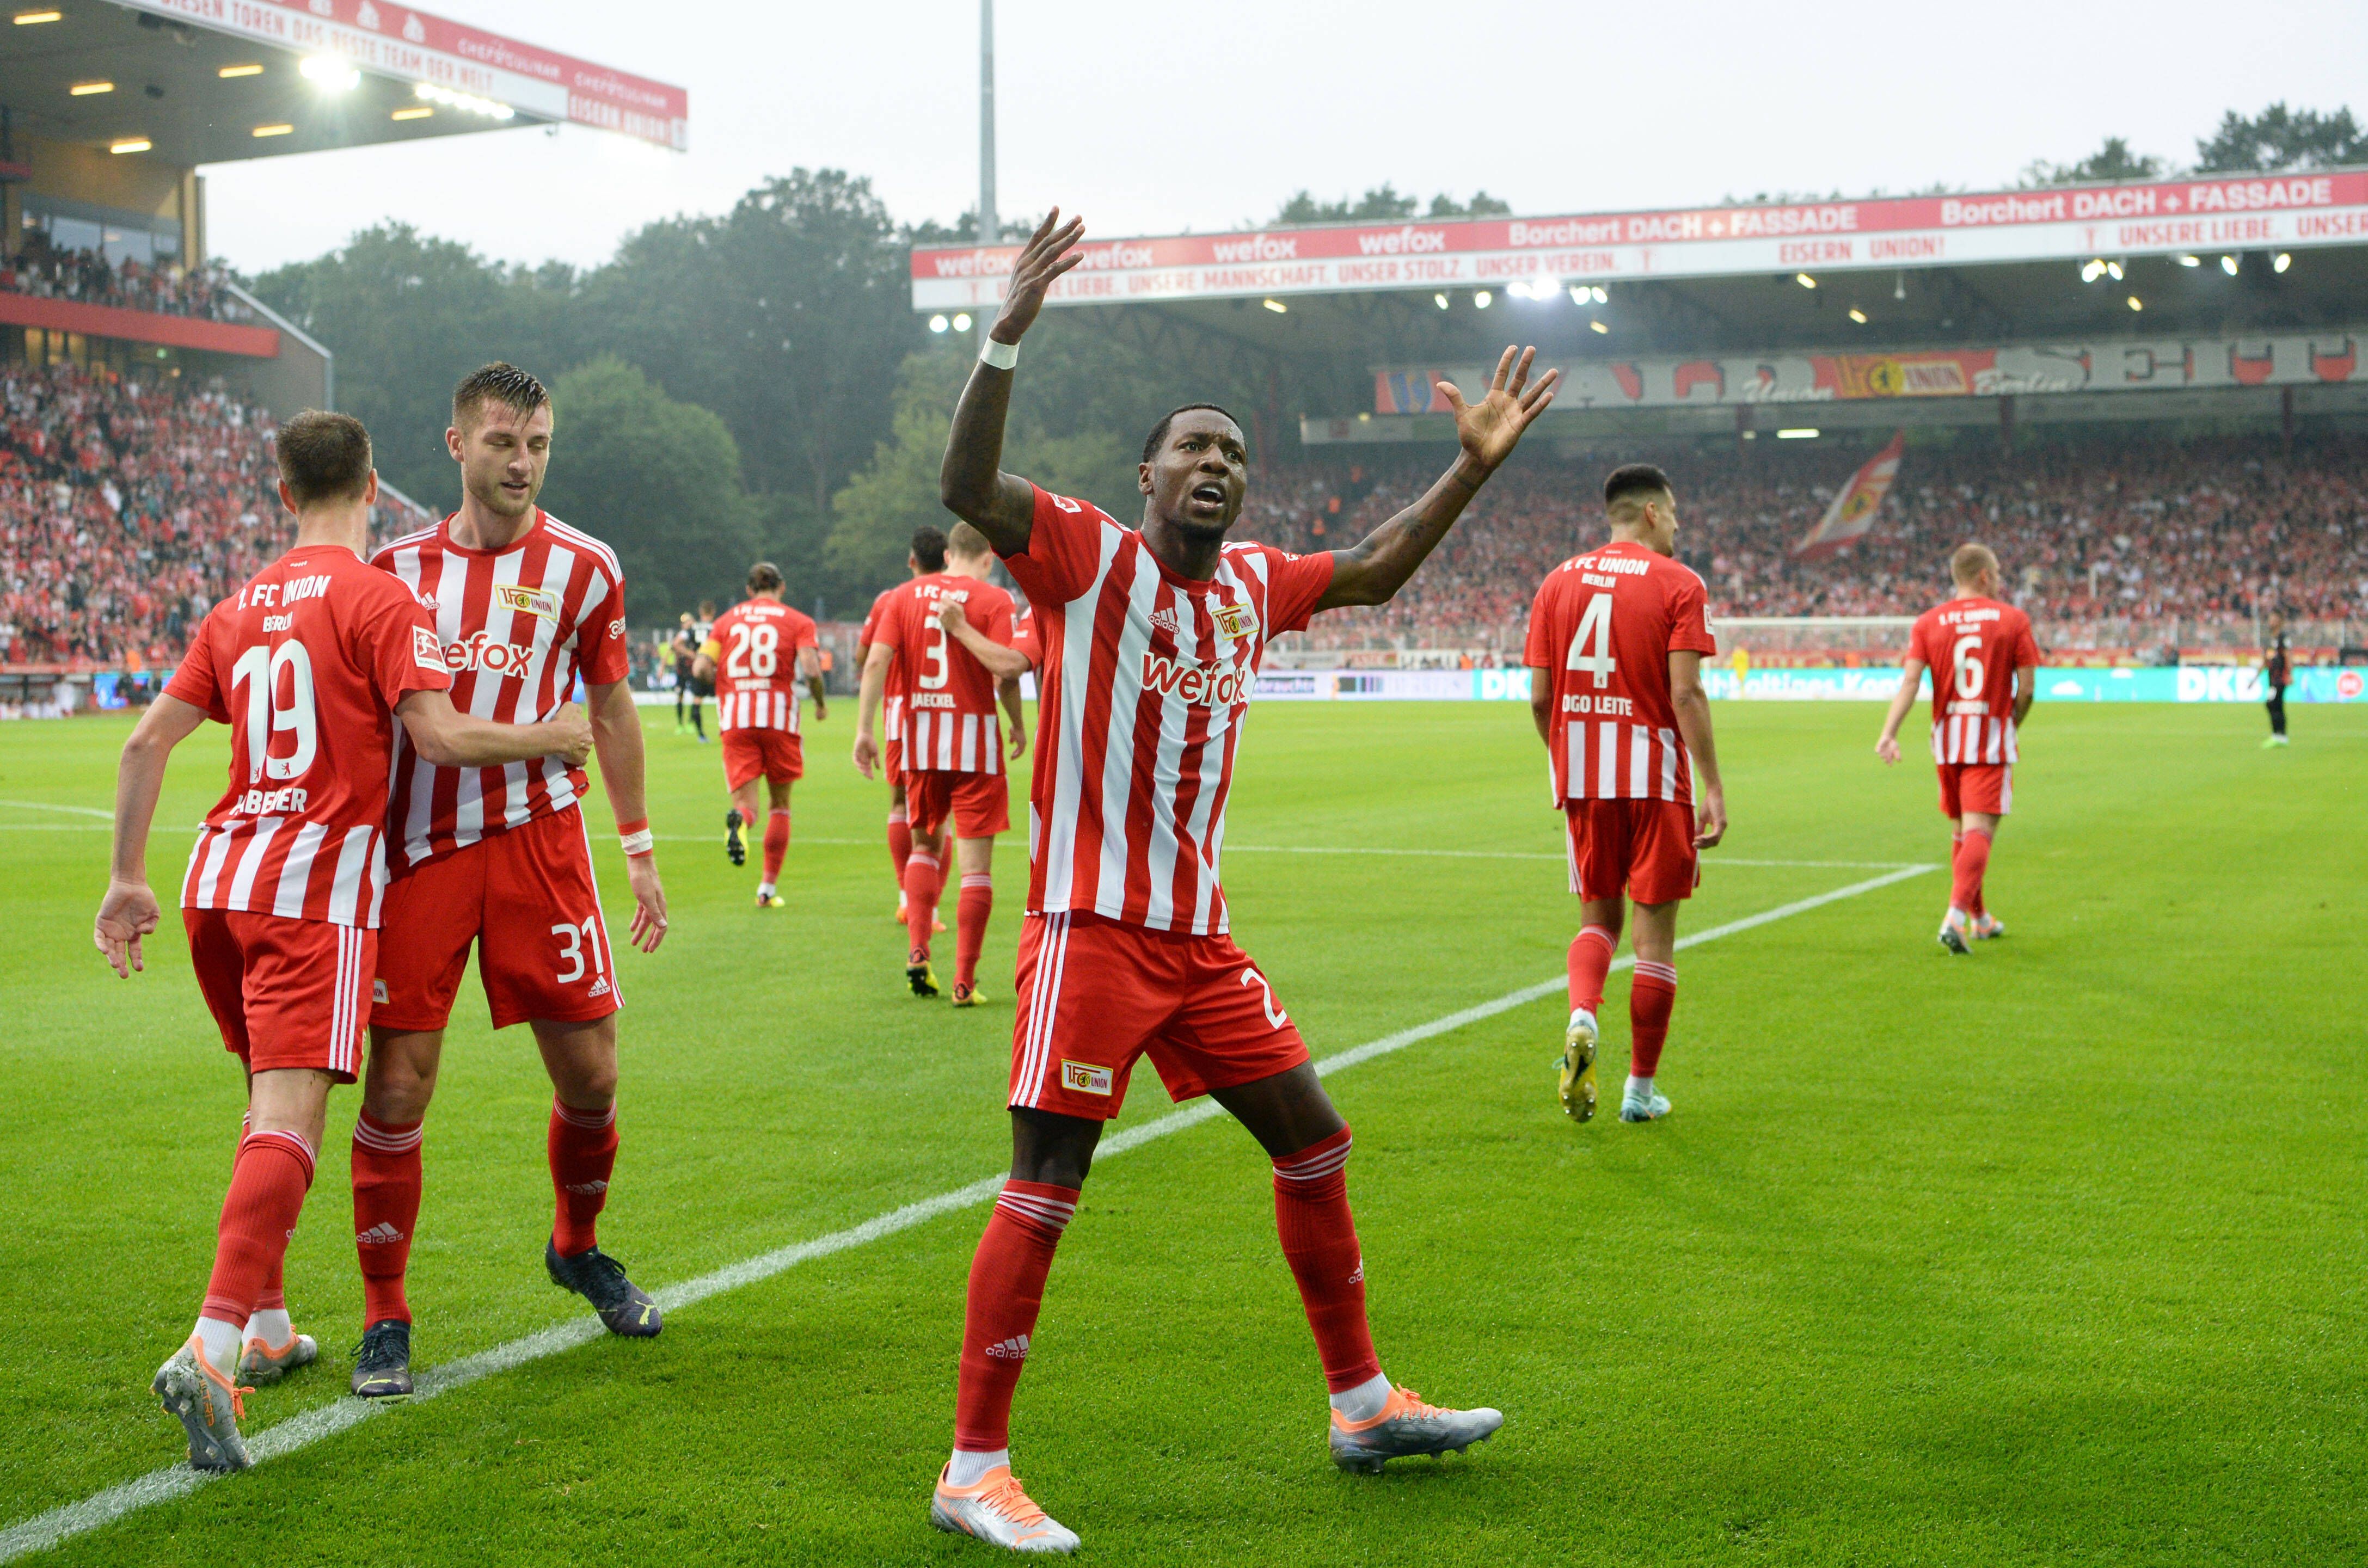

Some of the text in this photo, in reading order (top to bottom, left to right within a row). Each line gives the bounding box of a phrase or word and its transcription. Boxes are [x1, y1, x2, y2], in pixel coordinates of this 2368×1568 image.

[232, 2, 285, 35] TOREN
[383, 44, 421, 72] TEAM
[1941, 195, 2065, 225] Borchert
[2073, 189, 2156, 217] DACH
[2189, 179, 2332, 211] FASSADE
[1509, 220, 1620, 245] Borchert
[1628, 214, 1702, 240] DACH
[1730, 205, 1858, 236] FASSADE
[2119, 220, 2207, 246] UNSERE
[1212, 234, 1297, 262] wefox
[1358, 225, 1445, 255] wefox
[1779, 236, 1945, 263] EISERN UNION!
[934, 249, 1014, 276] wefox
[1074, 242, 1153, 269] wefox
[1128, 272, 1196, 293] UNSERE
[1339, 262, 1398, 283] UNSER
[1476, 256, 1538, 277] UNSER
[1575, 557, 1597, 569] FC
[1597, 557, 1650, 576] UNION
[1581, 573, 1617, 588] BERLIN
[251, 584, 280, 607] FC
[281, 575, 332, 607] UNION
[531, 598, 551, 613] UNION
[924, 584, 941, 599] FC
[1149, 614, 1180, 635] adidas
[727, 622, 778, 678] 28
[919, 615, 949, 689] 3
[1566, 593, 1616, 689] 4
[1142, 650, 1246, 706] wefox
[1953, 635, 1984, 700] 6
[1482, 670, 1532, 700] DK
[2177, 667, 2262, 701] DKB
[231, 638, 317, 784] 19
[1594, 696, 1633, 717] LEITE
[551, 915, 604, 983] 31
[588, 986, 611, 998] adidas
[1091, 1077, 1107, 1089] UNION
[356, 1233, 404, 1244] adidas
[985, 1347, 1028, 1358] adida
